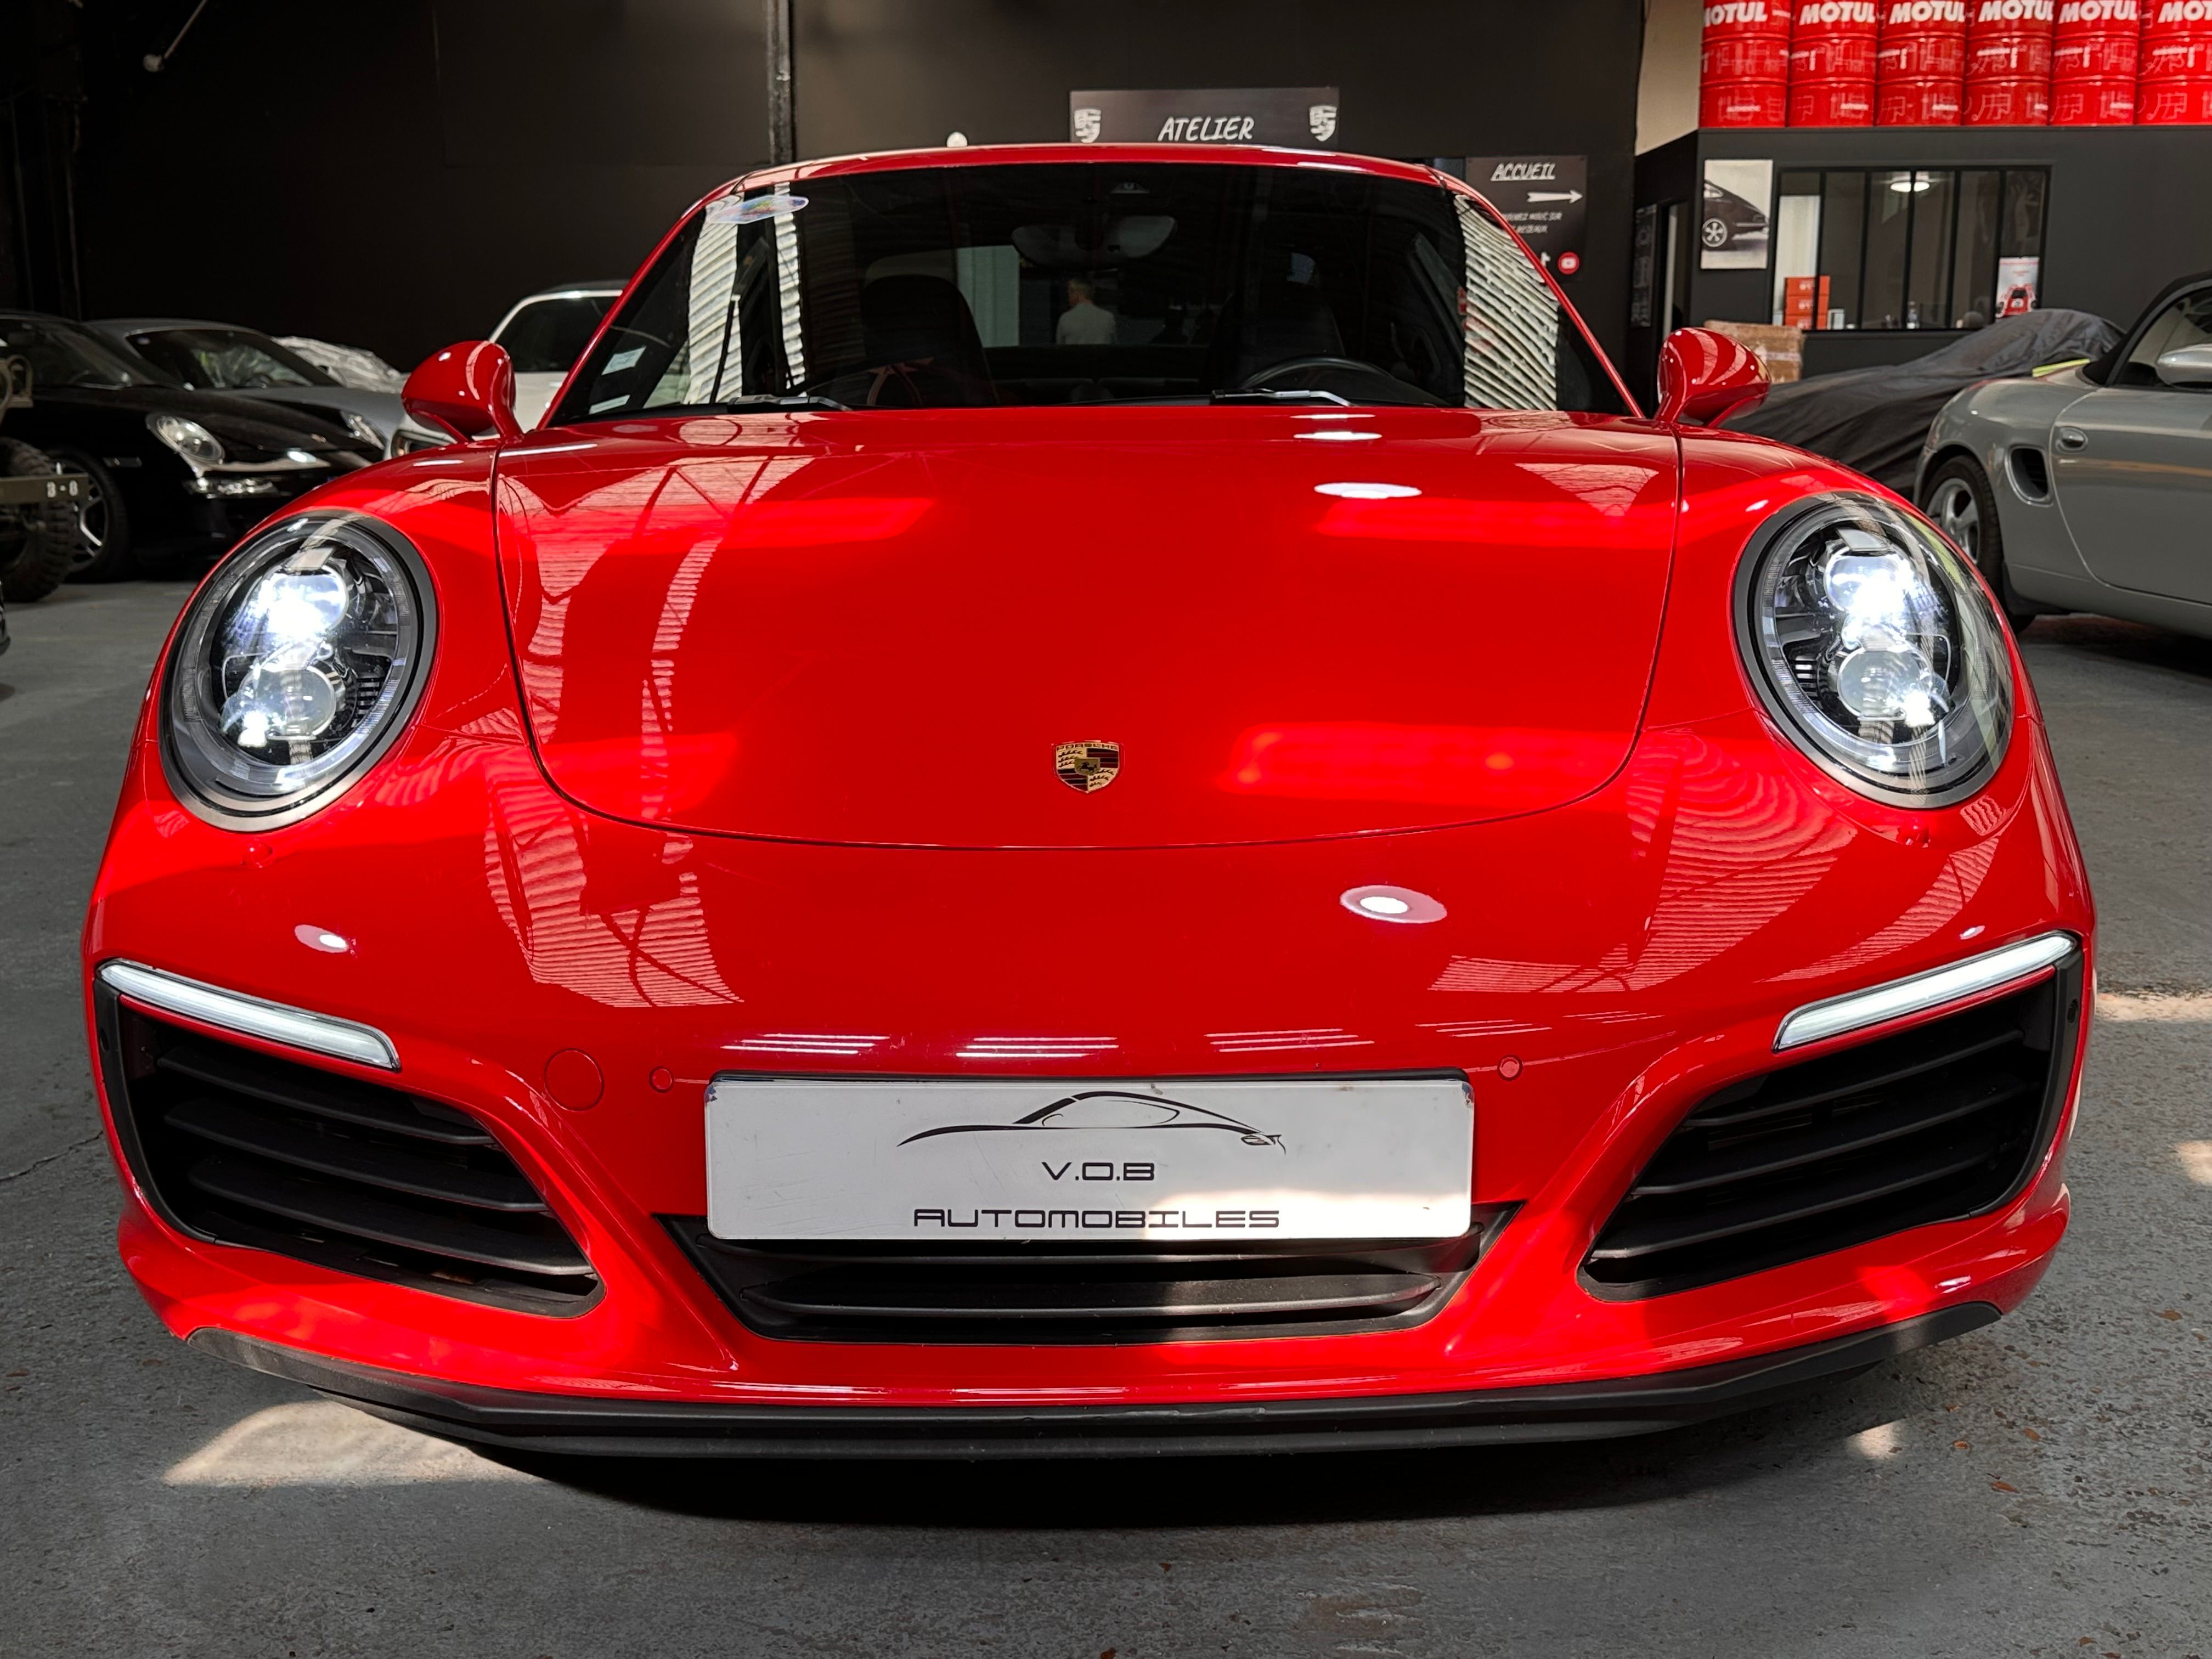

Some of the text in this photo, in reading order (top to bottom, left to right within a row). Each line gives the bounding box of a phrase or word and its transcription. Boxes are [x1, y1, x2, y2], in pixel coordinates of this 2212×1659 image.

[1799, 1, 1876, 25] MOTUL
[1889, 0, 1965, 24] MOTUL
[1978, 0, 2053, 22] MOTUL
[2058, 0, 2137, 24] MOTUL
[1157, 116, 1255, 142] ATELIER
[1490, 162, 1556, 182] ACCUEIL
[1041, 1161, 1155, 1181] V.O.B
[913, 1209, 1279, 1228] AUTOMOBILES
